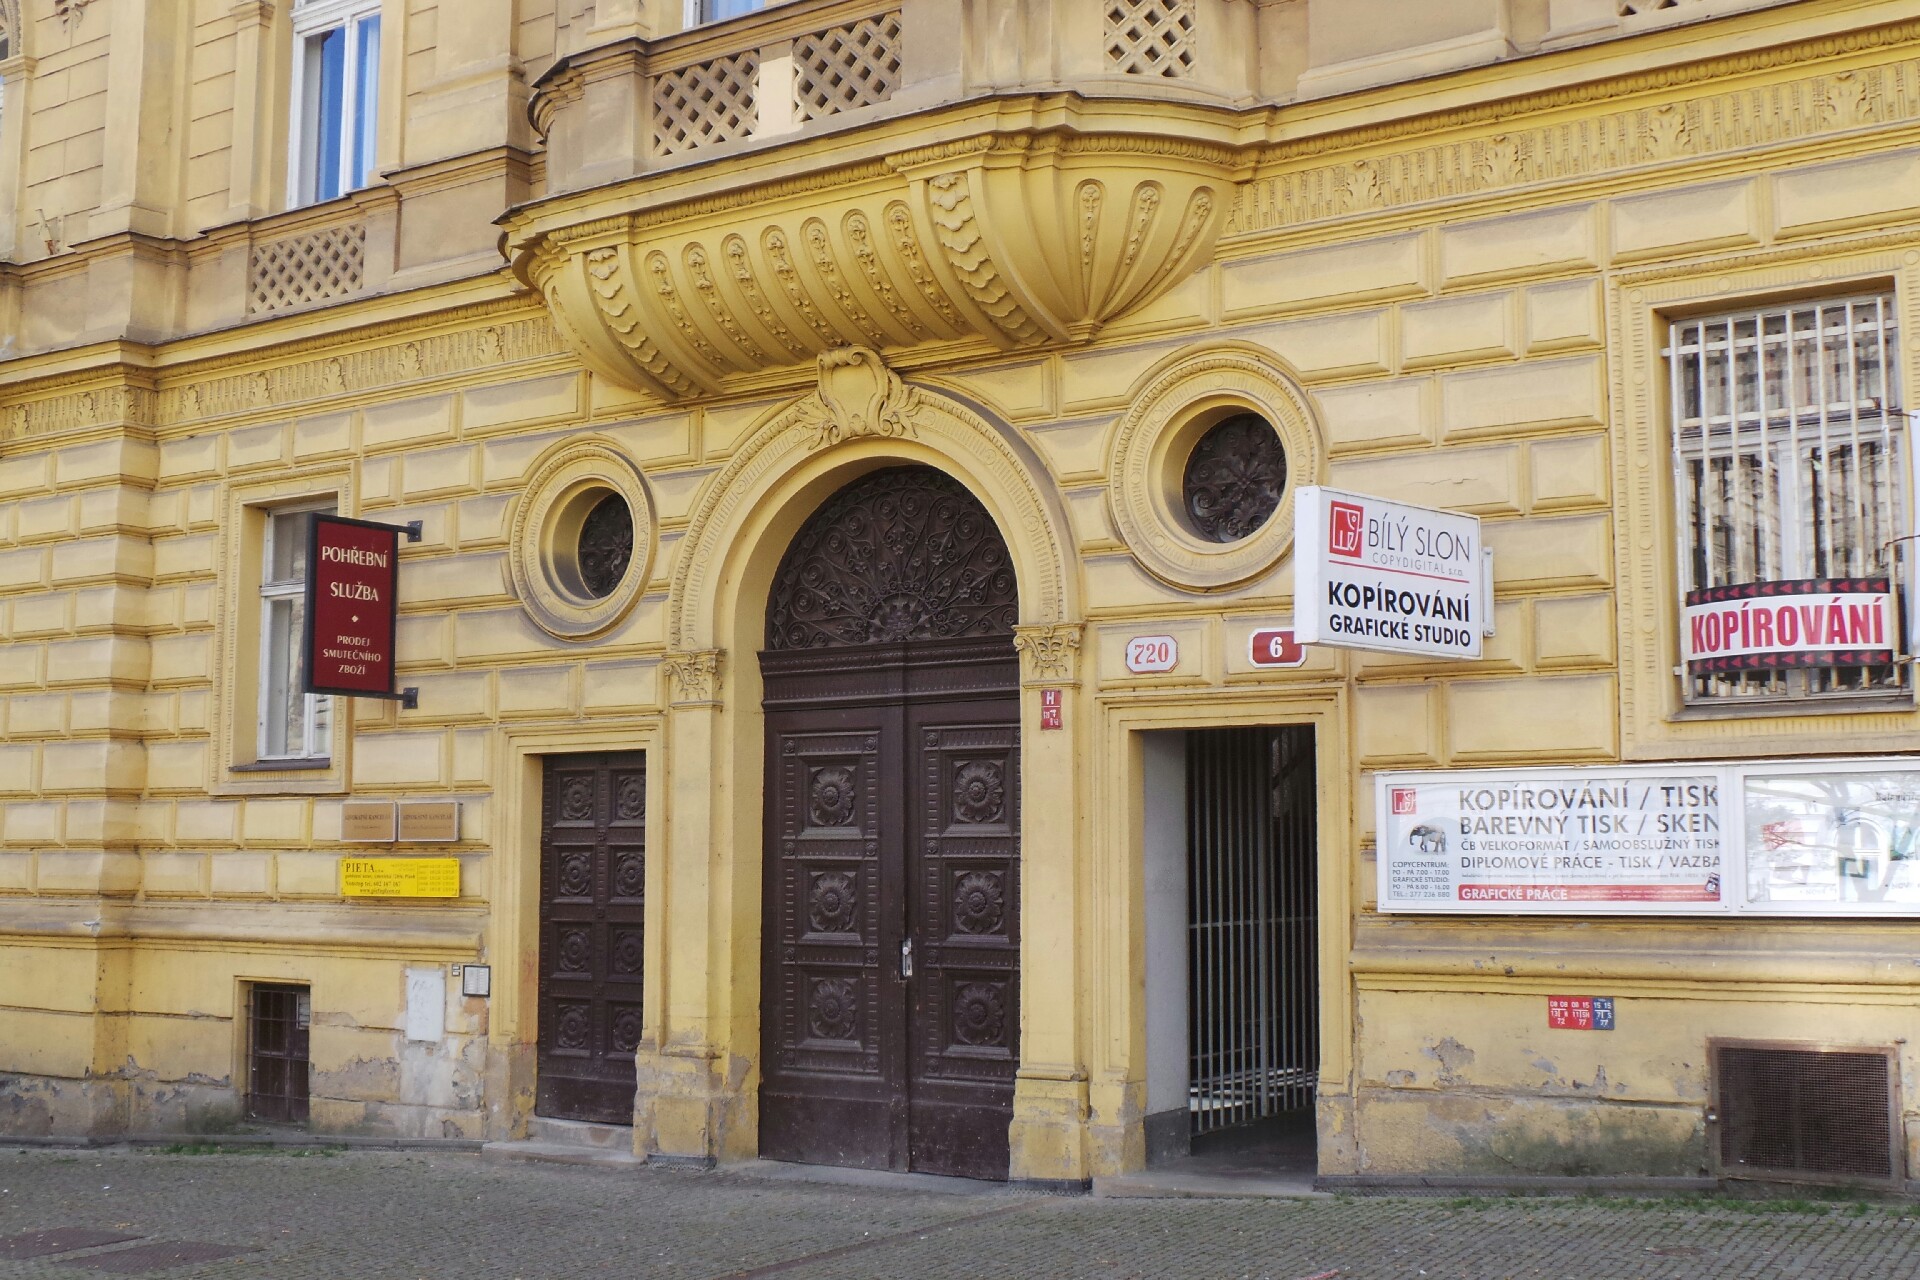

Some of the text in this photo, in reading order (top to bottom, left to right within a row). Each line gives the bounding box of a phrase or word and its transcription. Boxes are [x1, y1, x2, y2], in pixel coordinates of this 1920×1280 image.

[1368, 512, 1470, 563] BÍLÝ SLON
[321, 546, 388, 568] POHŘEBNÍ
[1372, 552, 1464, 577] COPYDIGITAL s.r.o.
[330, 581, 379, 602] SLUŽBA
[1328, 580, 1470, 622] KOPÍROVÁNÍ
[1329, 613, 1471, 647] GRAFICKÉ STUDIO
[1691, 597, 1884, 654] KOPÍROVÁNÍ
[336, 635, 370, 647] PRODEJ
[1269, 636, 1283, 658] 6
[322, 648, 382, 662] SMUTEČNÍHO
[1134, 643, 1169, 665] 720
[338, 663, 366, 675] ZBOŽÍ
[1046, 691, 1055, 705] H
[1459, 780, 1718, 811] KOPÍROVÁNÍ / TISK
[1460, 810, 1719, 836] BAREVNÝ TISK / SKEN
[1461, 838, 1476, 851] ČB
[1480, 837, 1570, 851] VELKOFORMÁT
[1573, 840, 1580, 851] /
[1583, 837, 1691, 851] SAMOOBSLUŽNÝ
[345, 863, 375, 873] PIETA
[1461, 853, 1549, 869] DIPLOMOVÉ
[1554, 853, 1603, 869] PRÁCE
[1619, 856, 1652, 868] TISK
[1657, 856, 1664, 869] /
[1669, 856, 1720, 868] VAZBA
[1461, 886, 1523, 900] GRAFICKÉ
[1526, 886, 1568, 900] PRÁCE
[1578, 1018, 1587, 1026] 77
